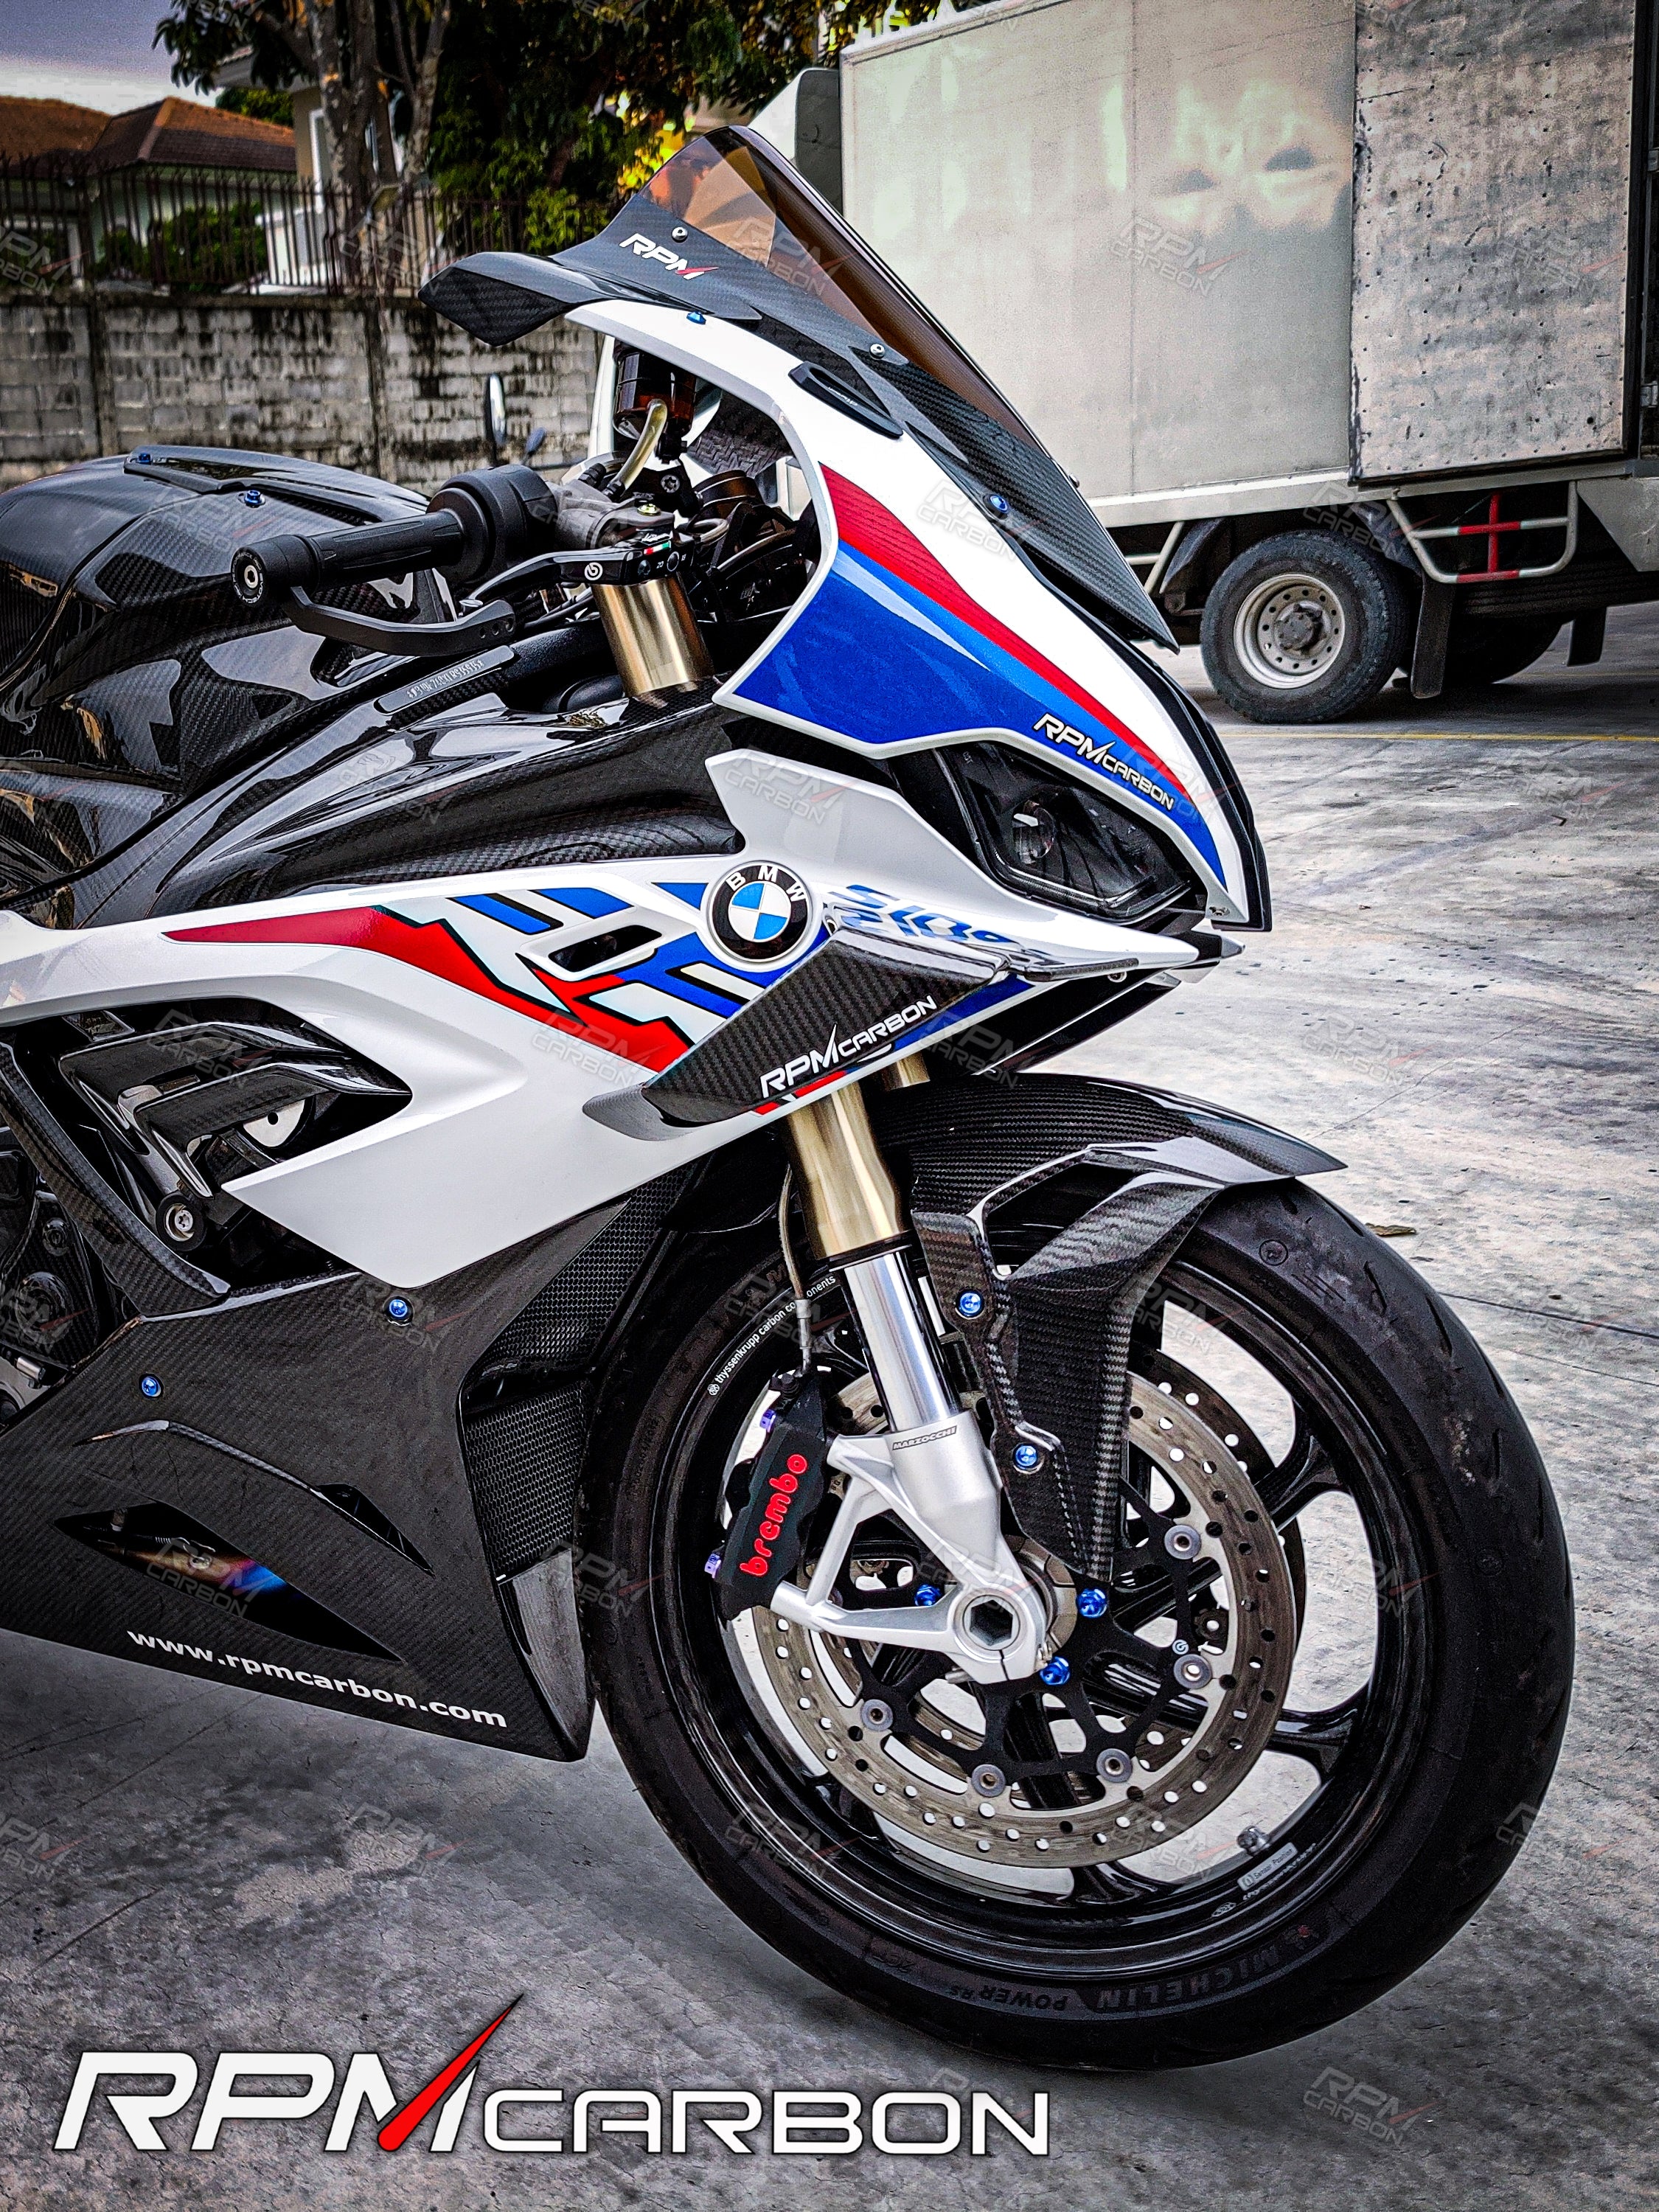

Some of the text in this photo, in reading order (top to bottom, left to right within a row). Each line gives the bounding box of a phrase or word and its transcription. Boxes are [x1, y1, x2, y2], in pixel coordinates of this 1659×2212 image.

[619, 233, 720, 280] RPM
[726, 865, 807, 902] BMW
[714, 1333, 760, 1384] thyssenkrupp
[758, 1310, 786, 1335] carbon
[785, 1276, 836, 1310] coonents
[892, 1425, 957, 1451] MARZOCCHI
[740, 1454, 808, 1576] brembo
[127, 1629, 508, 1728] www.rpmcarbon.com
[978, 1985, 1069, 2011] POWER
[1096, 1944, 1281, 2008] MICHELIN
